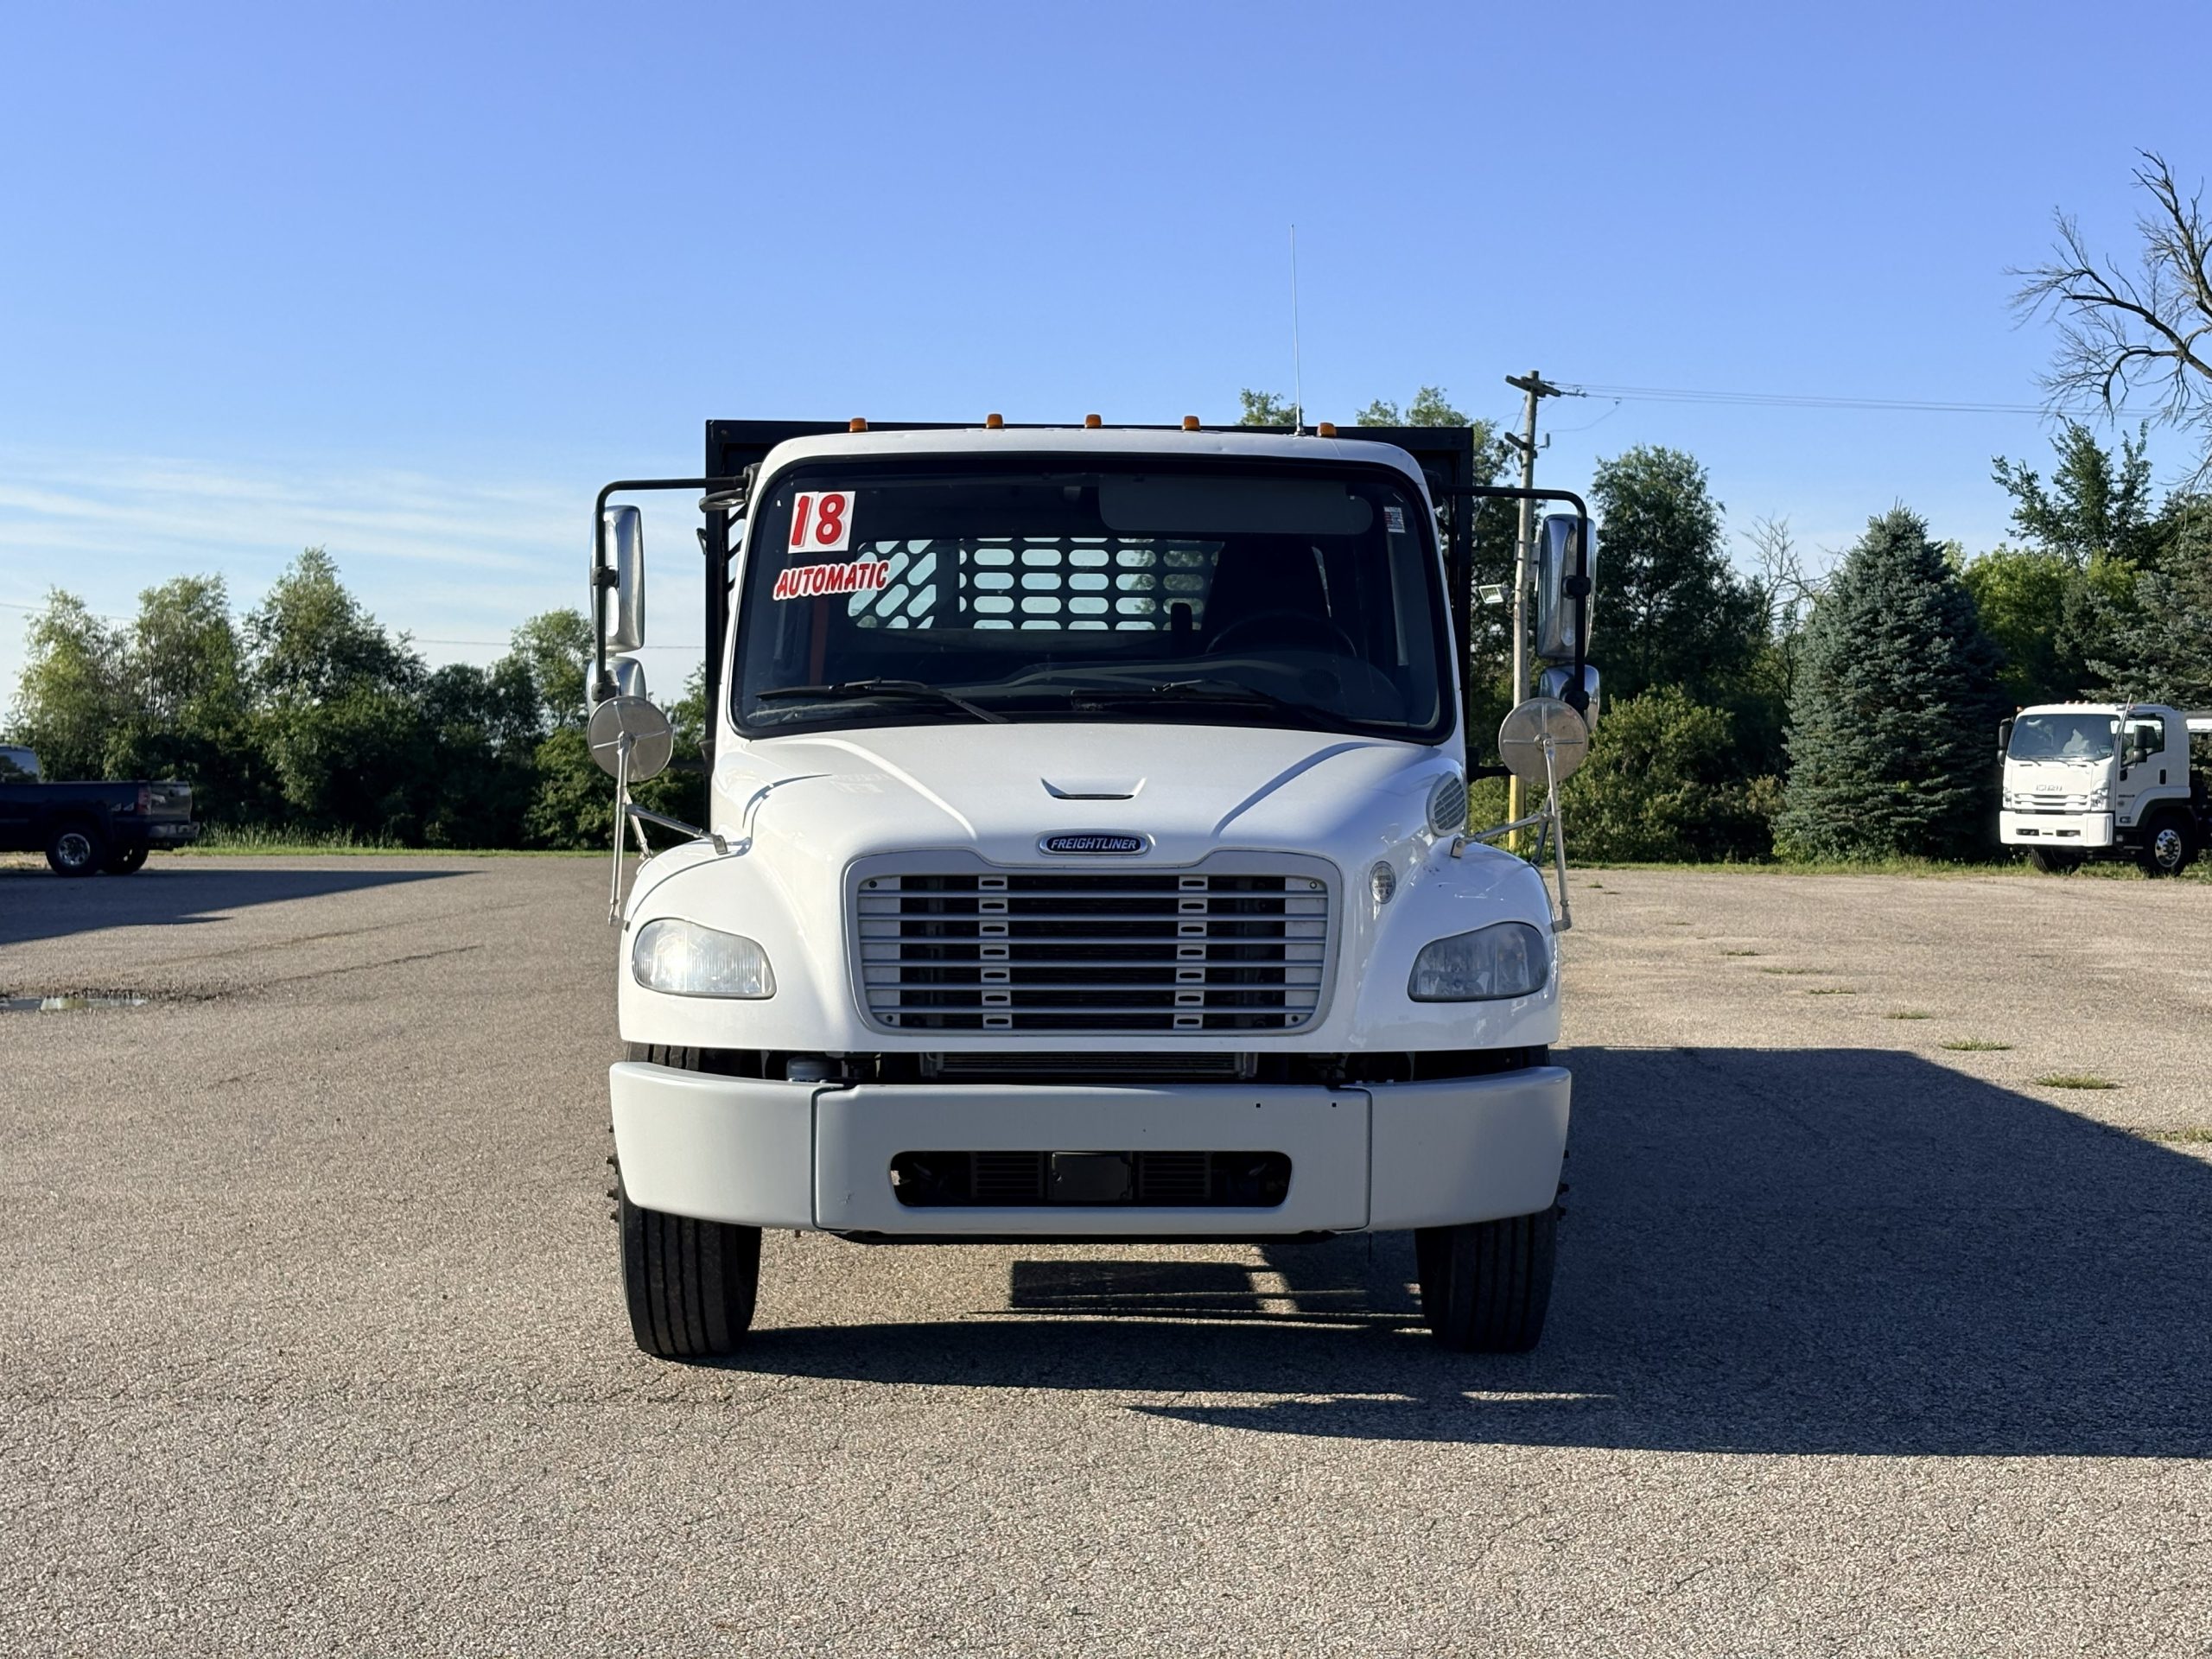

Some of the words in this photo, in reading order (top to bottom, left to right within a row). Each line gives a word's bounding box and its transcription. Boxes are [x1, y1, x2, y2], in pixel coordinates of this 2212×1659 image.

[791, 493, 847, 547] 18
[774, 561, 890, 600] AUTOMATIC
[1051, 837, 1137, 849] FREIGHTLINER
